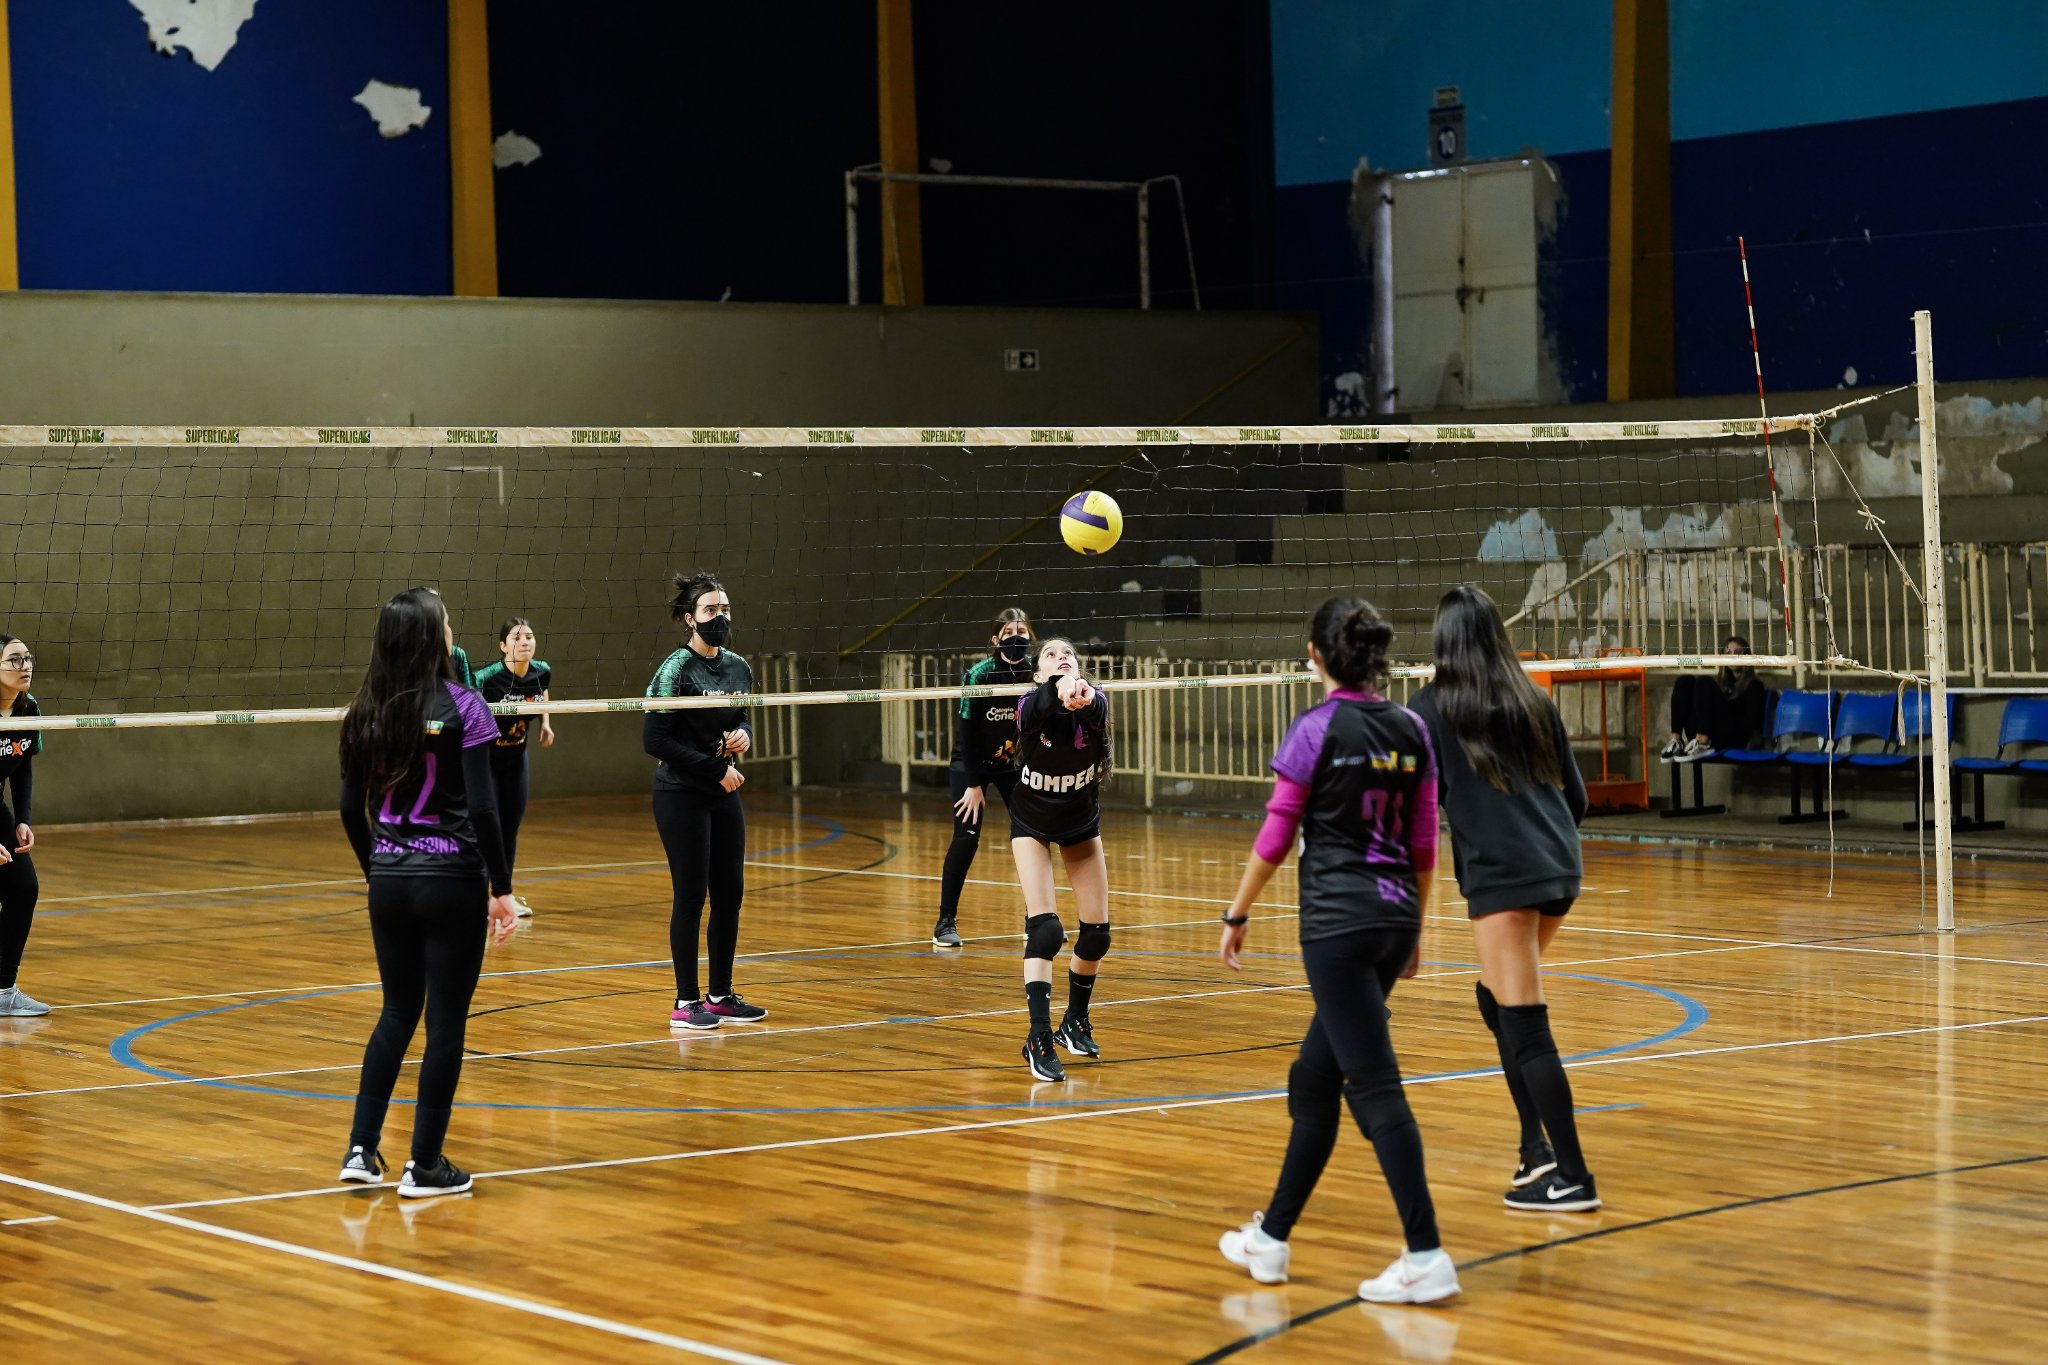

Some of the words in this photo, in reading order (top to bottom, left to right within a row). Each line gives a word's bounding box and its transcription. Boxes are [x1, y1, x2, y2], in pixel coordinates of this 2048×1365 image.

[49, 429, 103, 443] SUPERLIGA
[186, 429, 239, 443] SUPERLIGA
[318, 430, 370, 443] SUPERLIGA
[447, 430, 496, 443] SUPERLIGA
[572, 431, 619, 443] SUPERLIGA
[692, 431, 738, 443] SUPERLIGA
[809, 431, 854, 443] SUPERLIGA
[922, 431, 965, 443] SUPERLIGA
[986, 710, 1018, 722] Cone
[1022, 764, 1095, 793] COMPER
